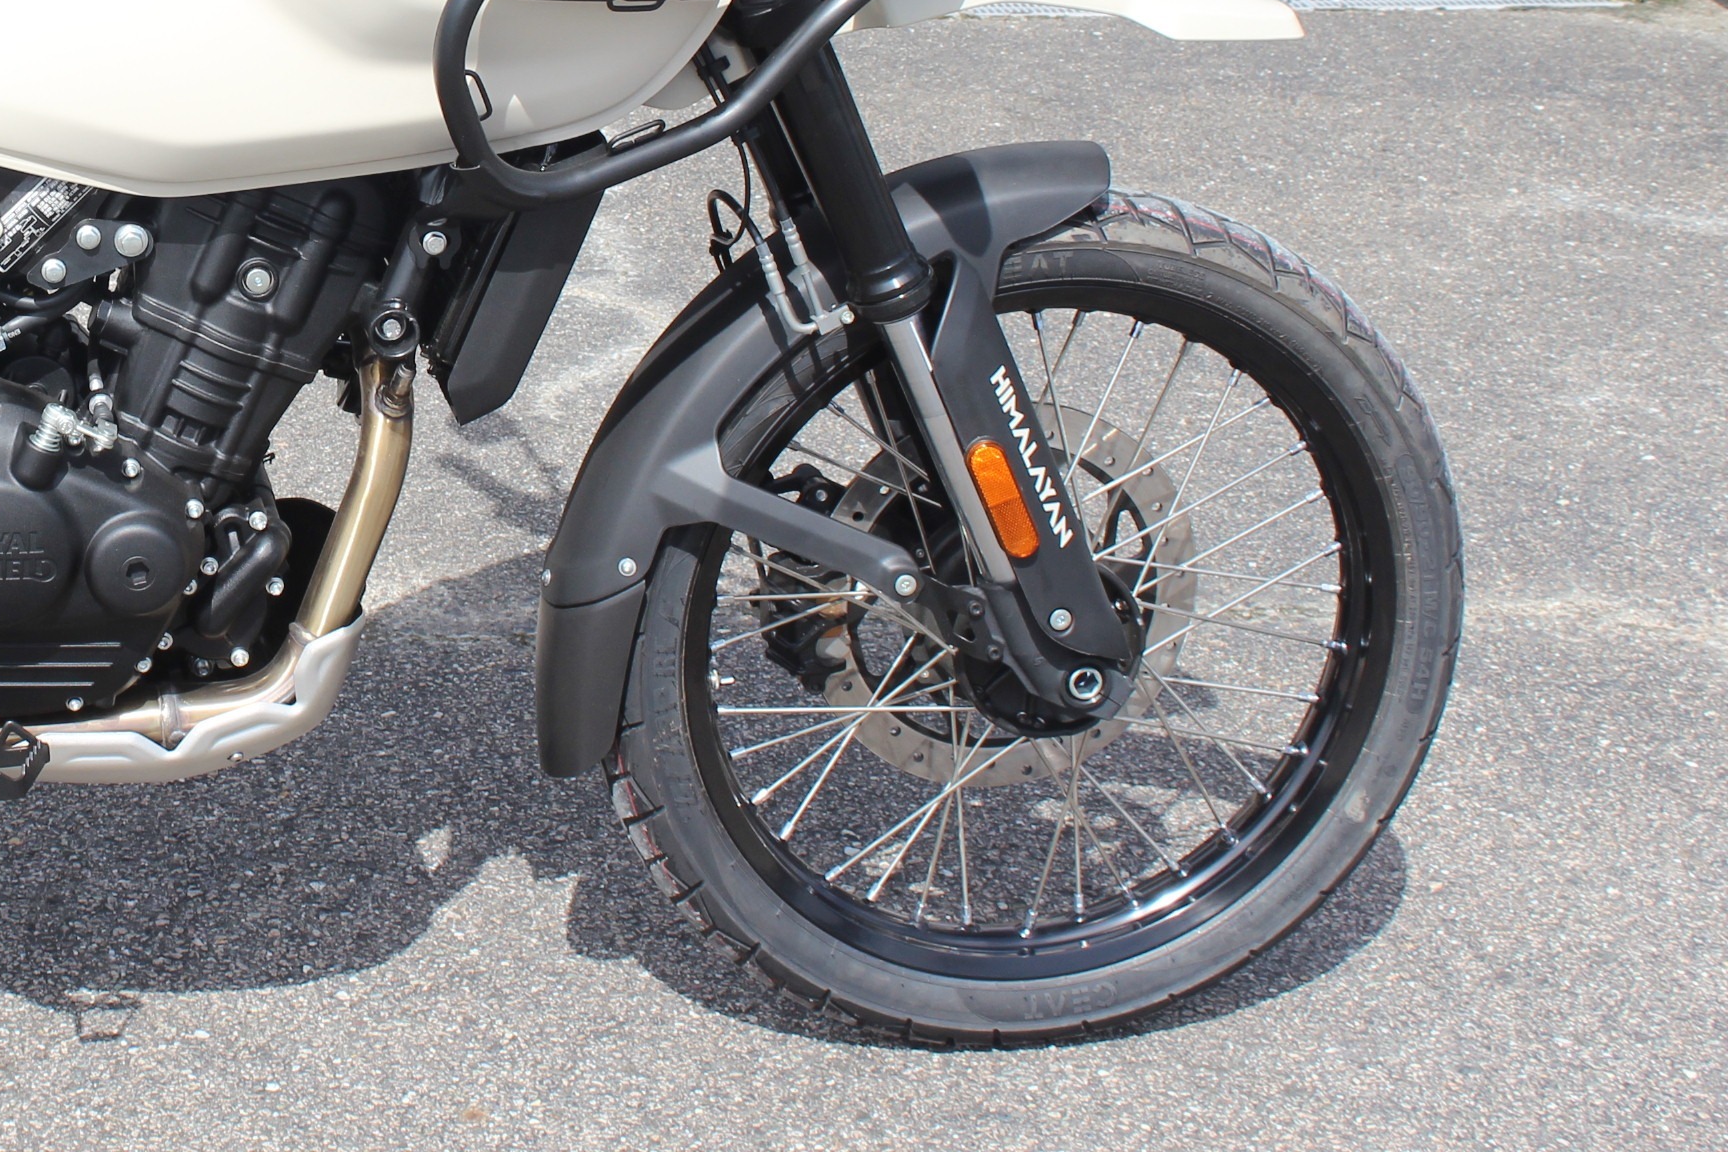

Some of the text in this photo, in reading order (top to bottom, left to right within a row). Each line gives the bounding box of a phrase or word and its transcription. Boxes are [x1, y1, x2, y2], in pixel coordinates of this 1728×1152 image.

[1002, 252, 1074, 281] EAT
[990, 365, 1073, 548] HIMALAYAN
[1023, 981, 1118, 1020] CEAT
